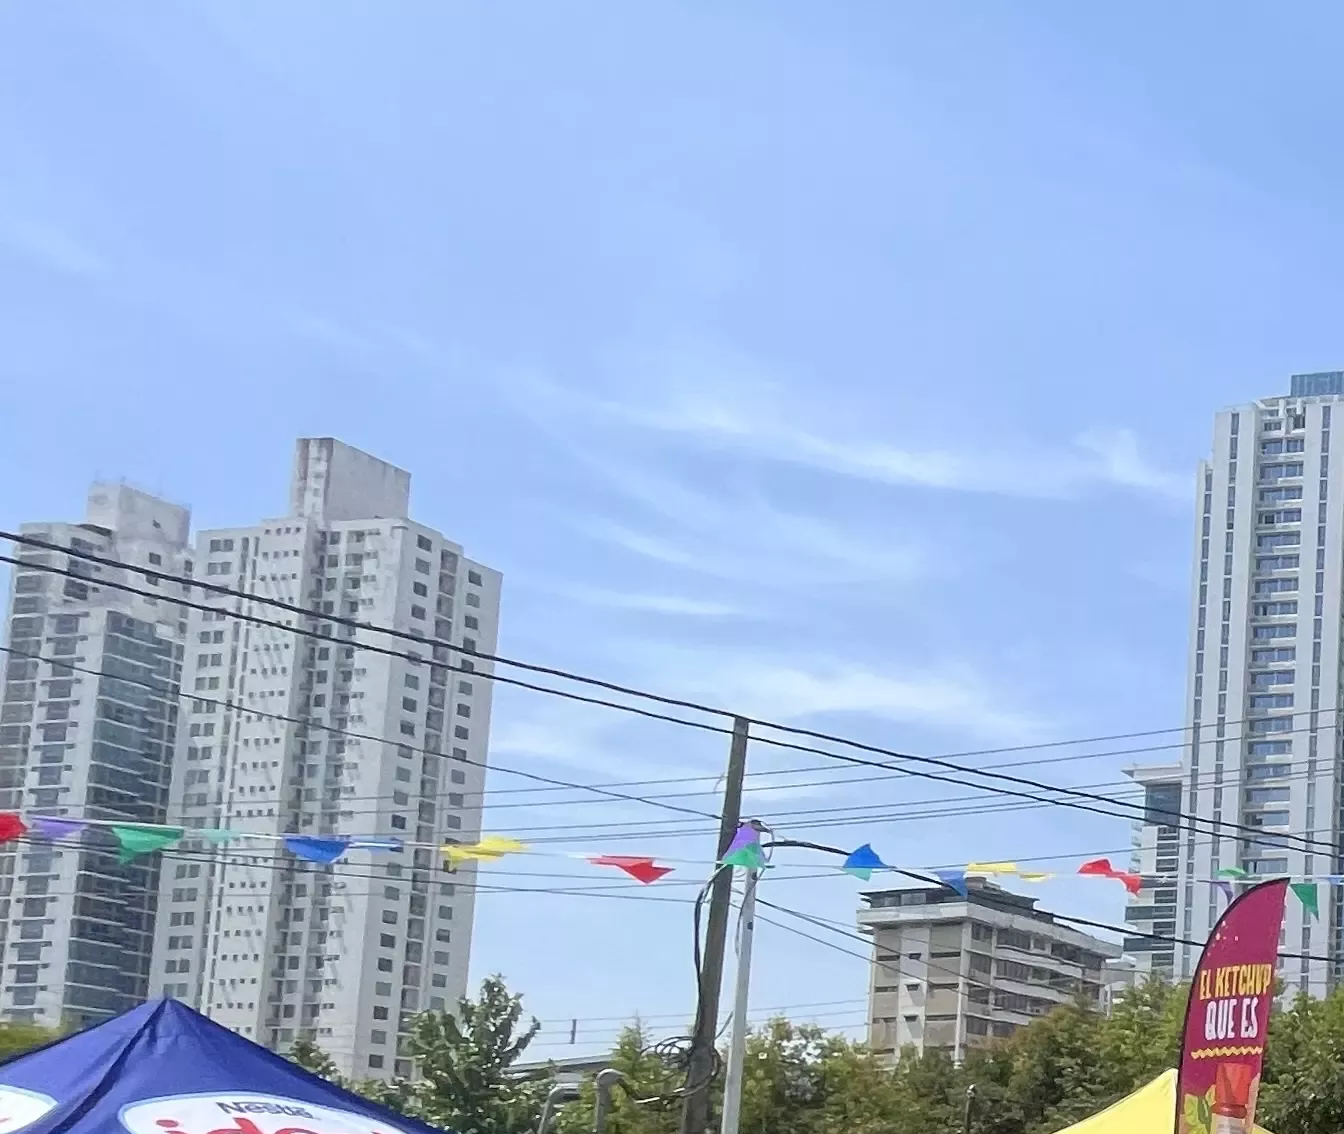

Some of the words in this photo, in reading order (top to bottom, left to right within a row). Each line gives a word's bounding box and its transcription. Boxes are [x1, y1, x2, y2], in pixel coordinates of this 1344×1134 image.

[1200, 968, 1211, 1000] EL
[1215, 963, 1272, 998] KETCHUP
[1205, 999, 1237, 1041] QUE
[1241, 997, 1259, 1038] ES
